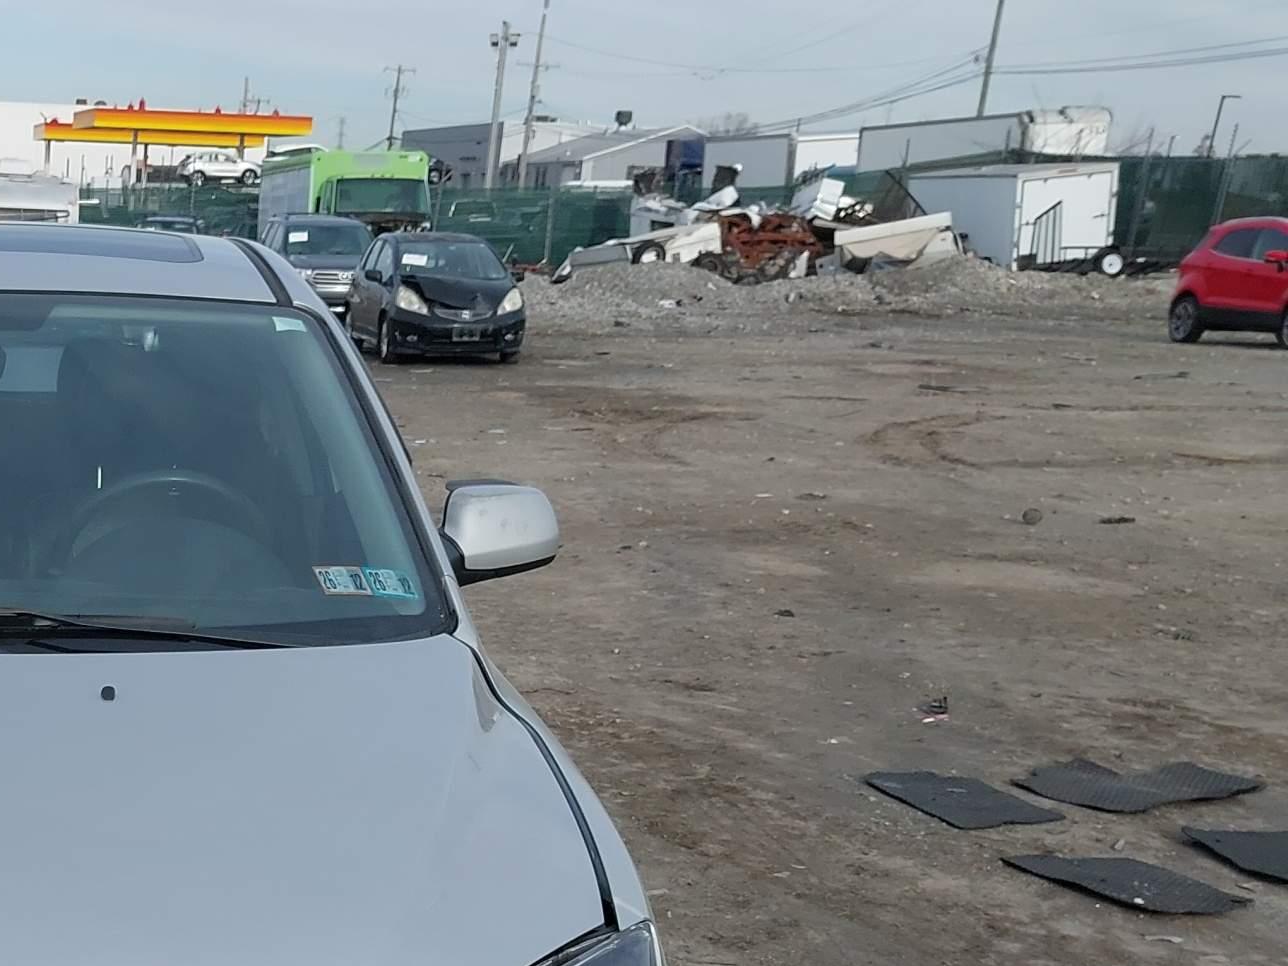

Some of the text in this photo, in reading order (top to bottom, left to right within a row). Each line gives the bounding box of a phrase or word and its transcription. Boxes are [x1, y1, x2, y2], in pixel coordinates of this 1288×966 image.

[318, 570, 337, 590] 26
[350, 573, 367, 591] 12
[369, 571, 387, 592] 26
